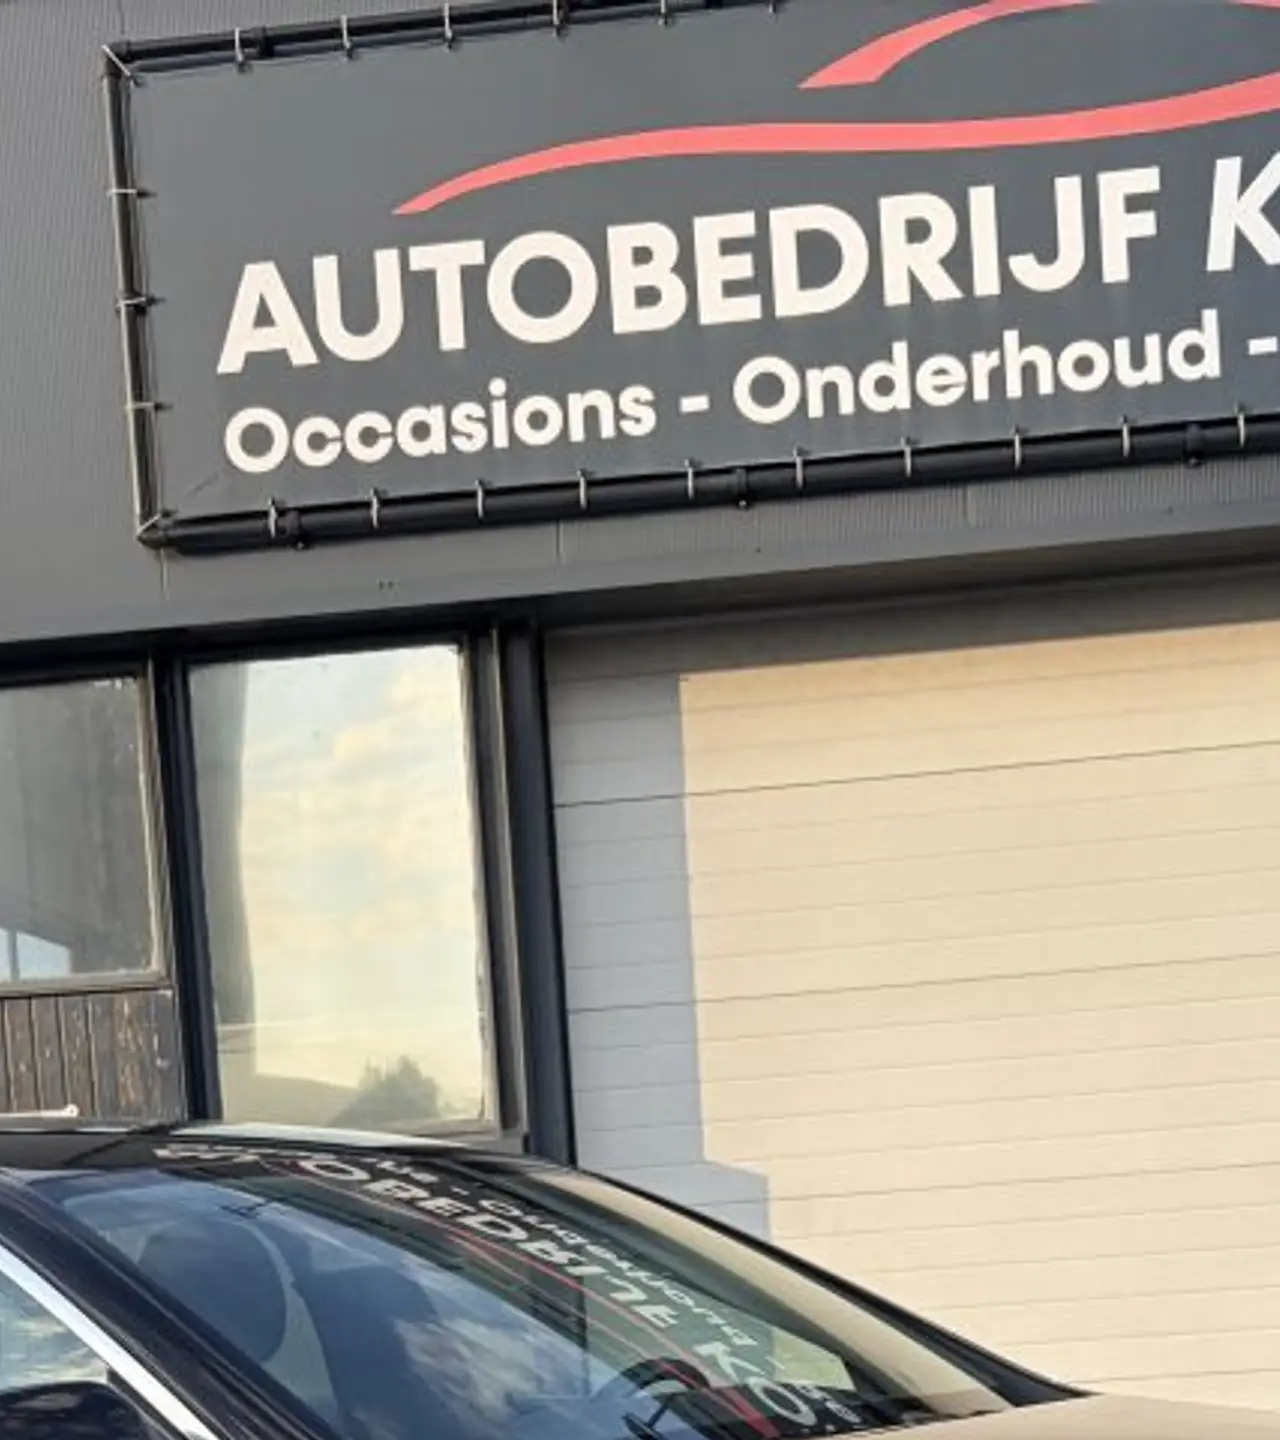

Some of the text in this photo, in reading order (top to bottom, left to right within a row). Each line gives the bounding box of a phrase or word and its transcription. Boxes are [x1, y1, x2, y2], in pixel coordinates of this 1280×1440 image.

[215, 165, 1161, 375] AUTOBEDRIJF
[224, 384, 657, 474] Occasions
[733, 308, 1221, 424] Onderhoud
